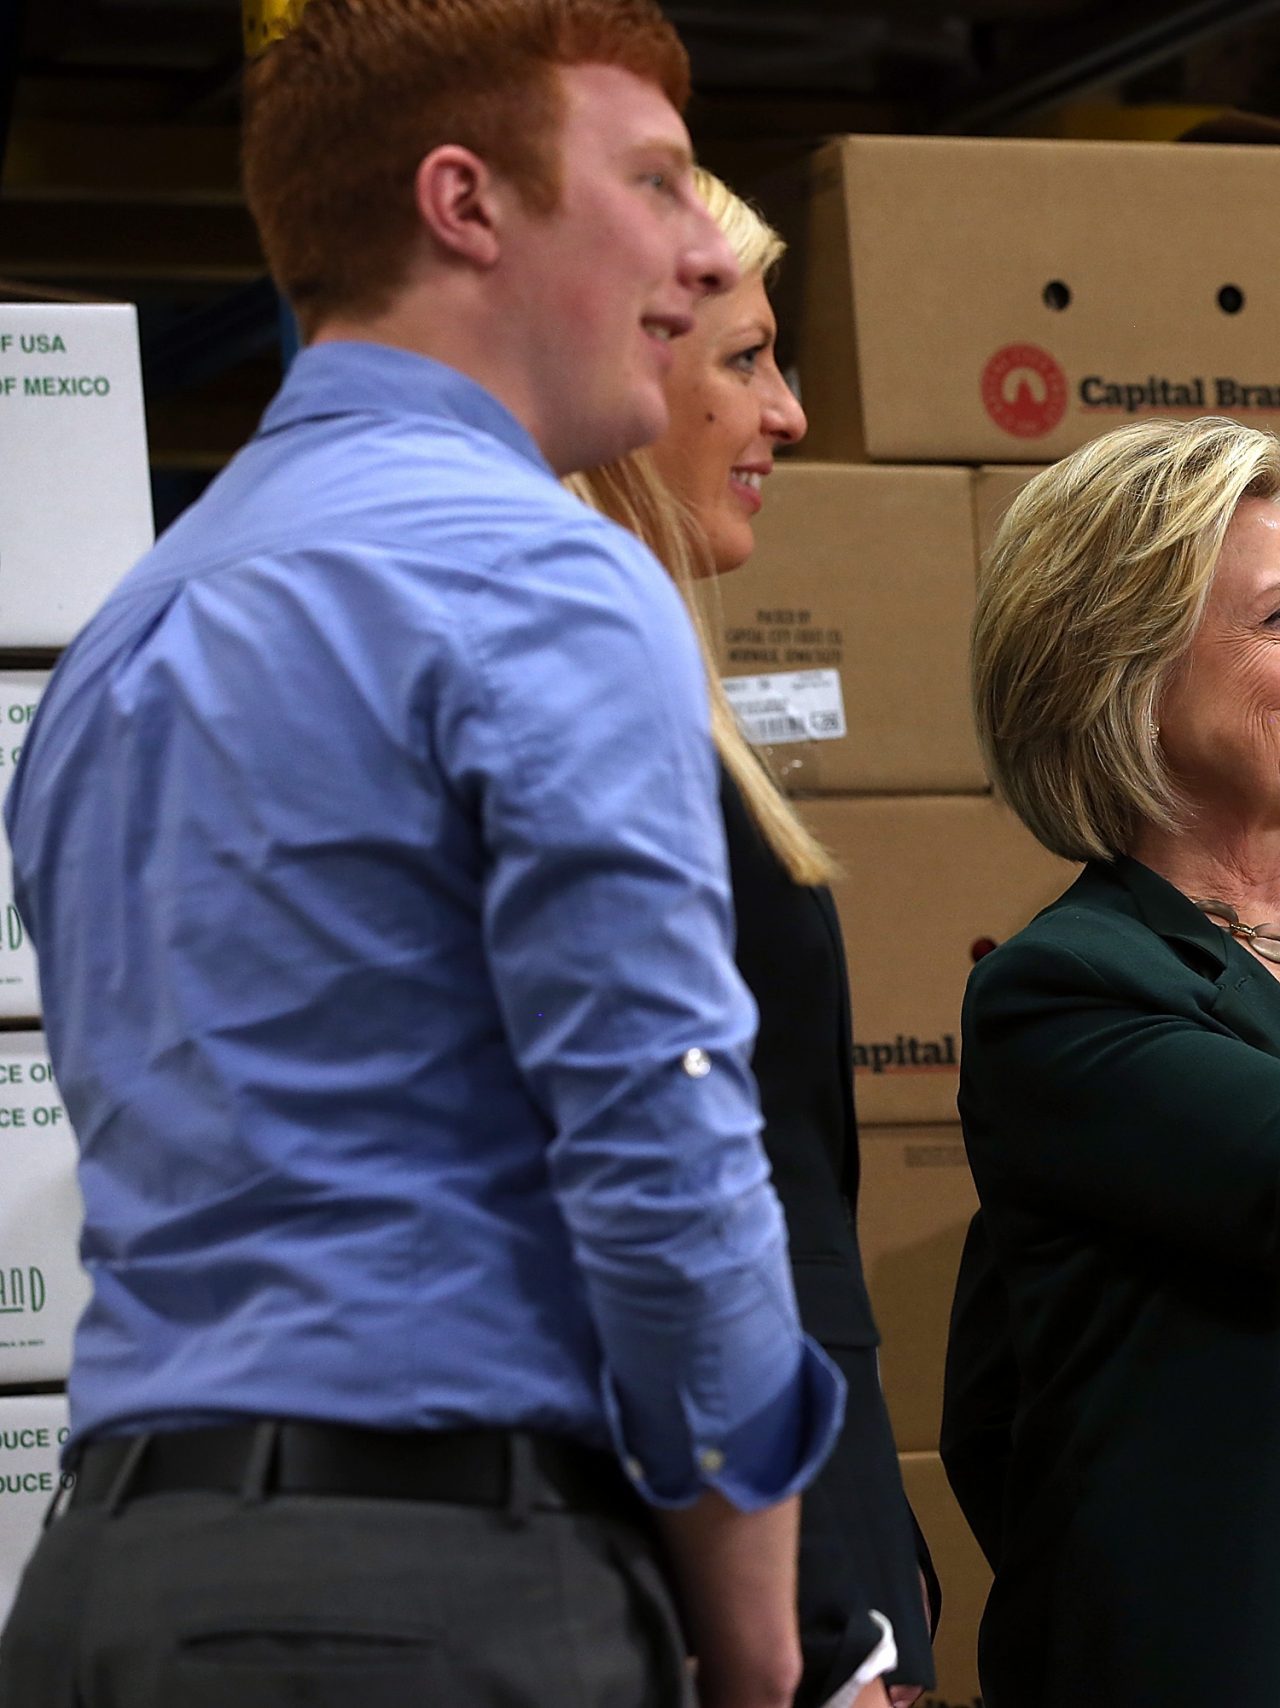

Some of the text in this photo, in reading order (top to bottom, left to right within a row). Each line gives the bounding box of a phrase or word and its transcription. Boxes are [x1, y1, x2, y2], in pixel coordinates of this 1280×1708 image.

[20, 334, 66, 354] USA
[23, 376, 110, 397] MEXICO
[1078, 376, 1206, 413] Capital
[853, 1034, 956, 1073] apital
[33, 1107, 63, 1127] OF
